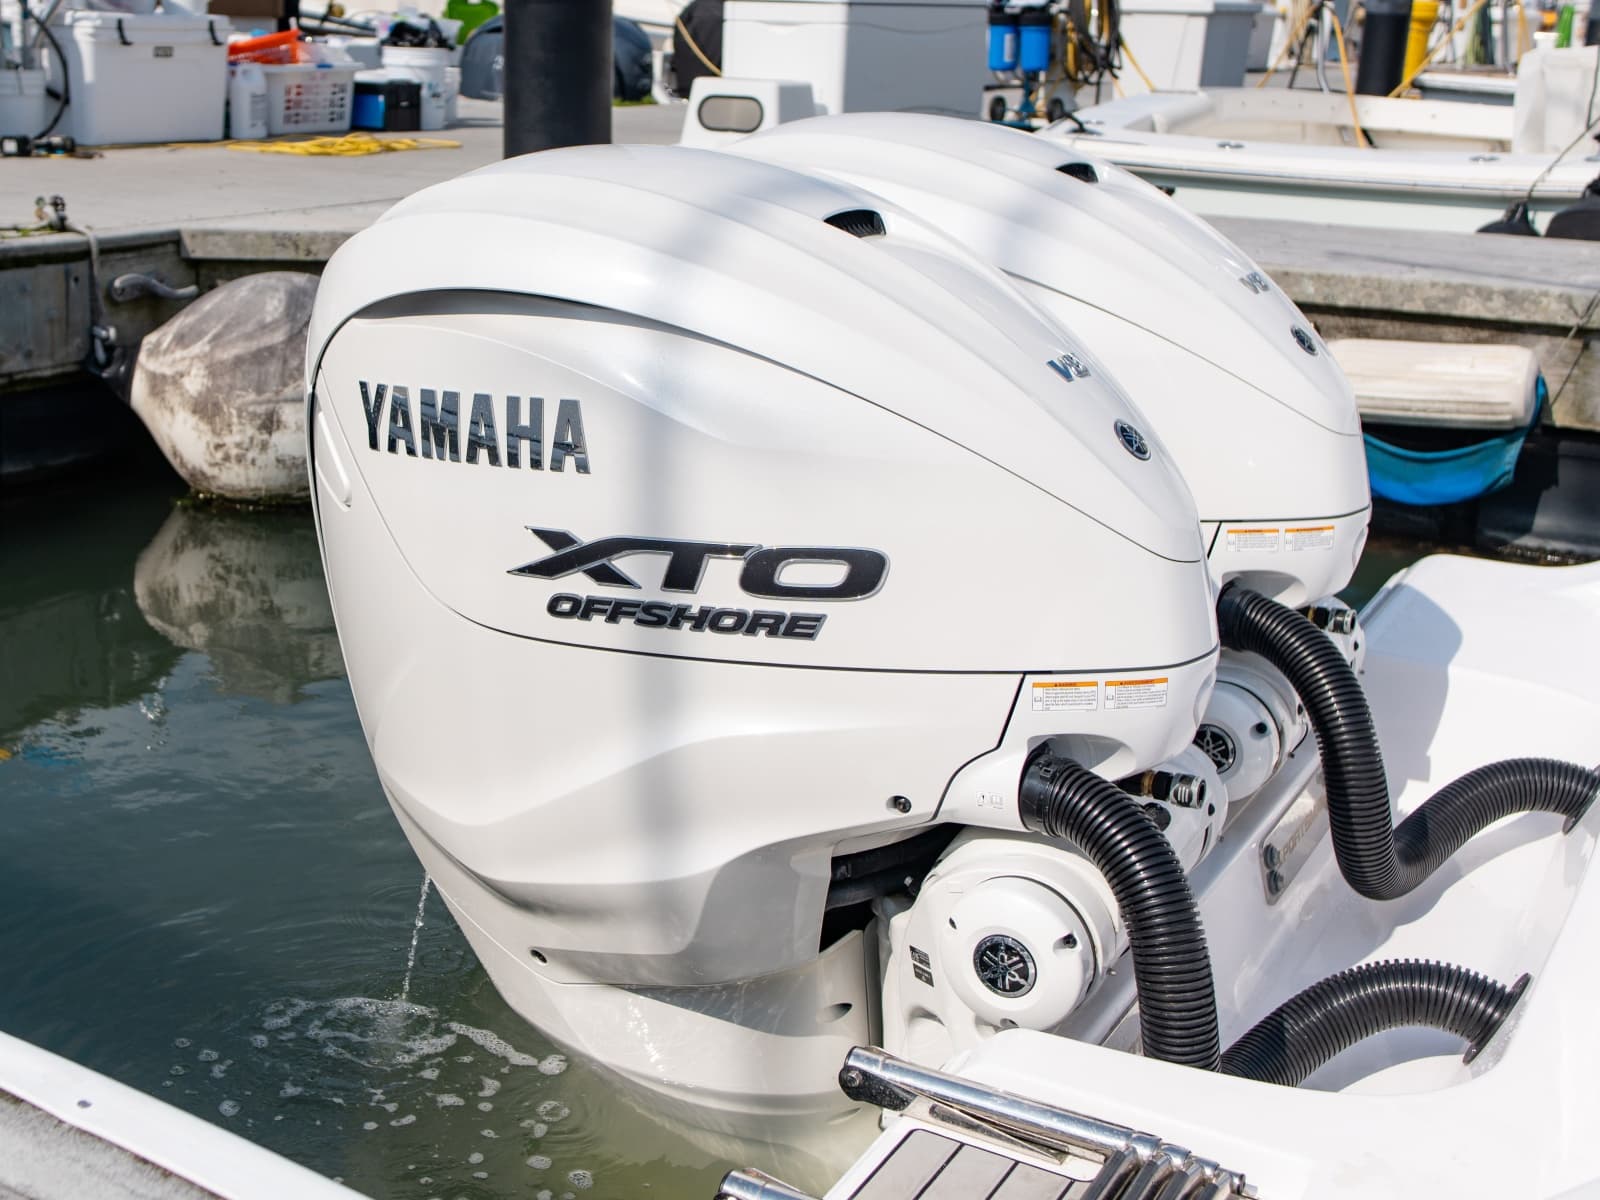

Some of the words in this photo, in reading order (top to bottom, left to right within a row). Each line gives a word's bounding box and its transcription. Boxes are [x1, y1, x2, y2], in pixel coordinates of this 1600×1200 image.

[1046, 352, 1091, 382] V8
[358, 380, 592, 475] YAMAHA
[506, 525, 890, 601] XTO
[546, 592, 828, 641] OFFSHORE
